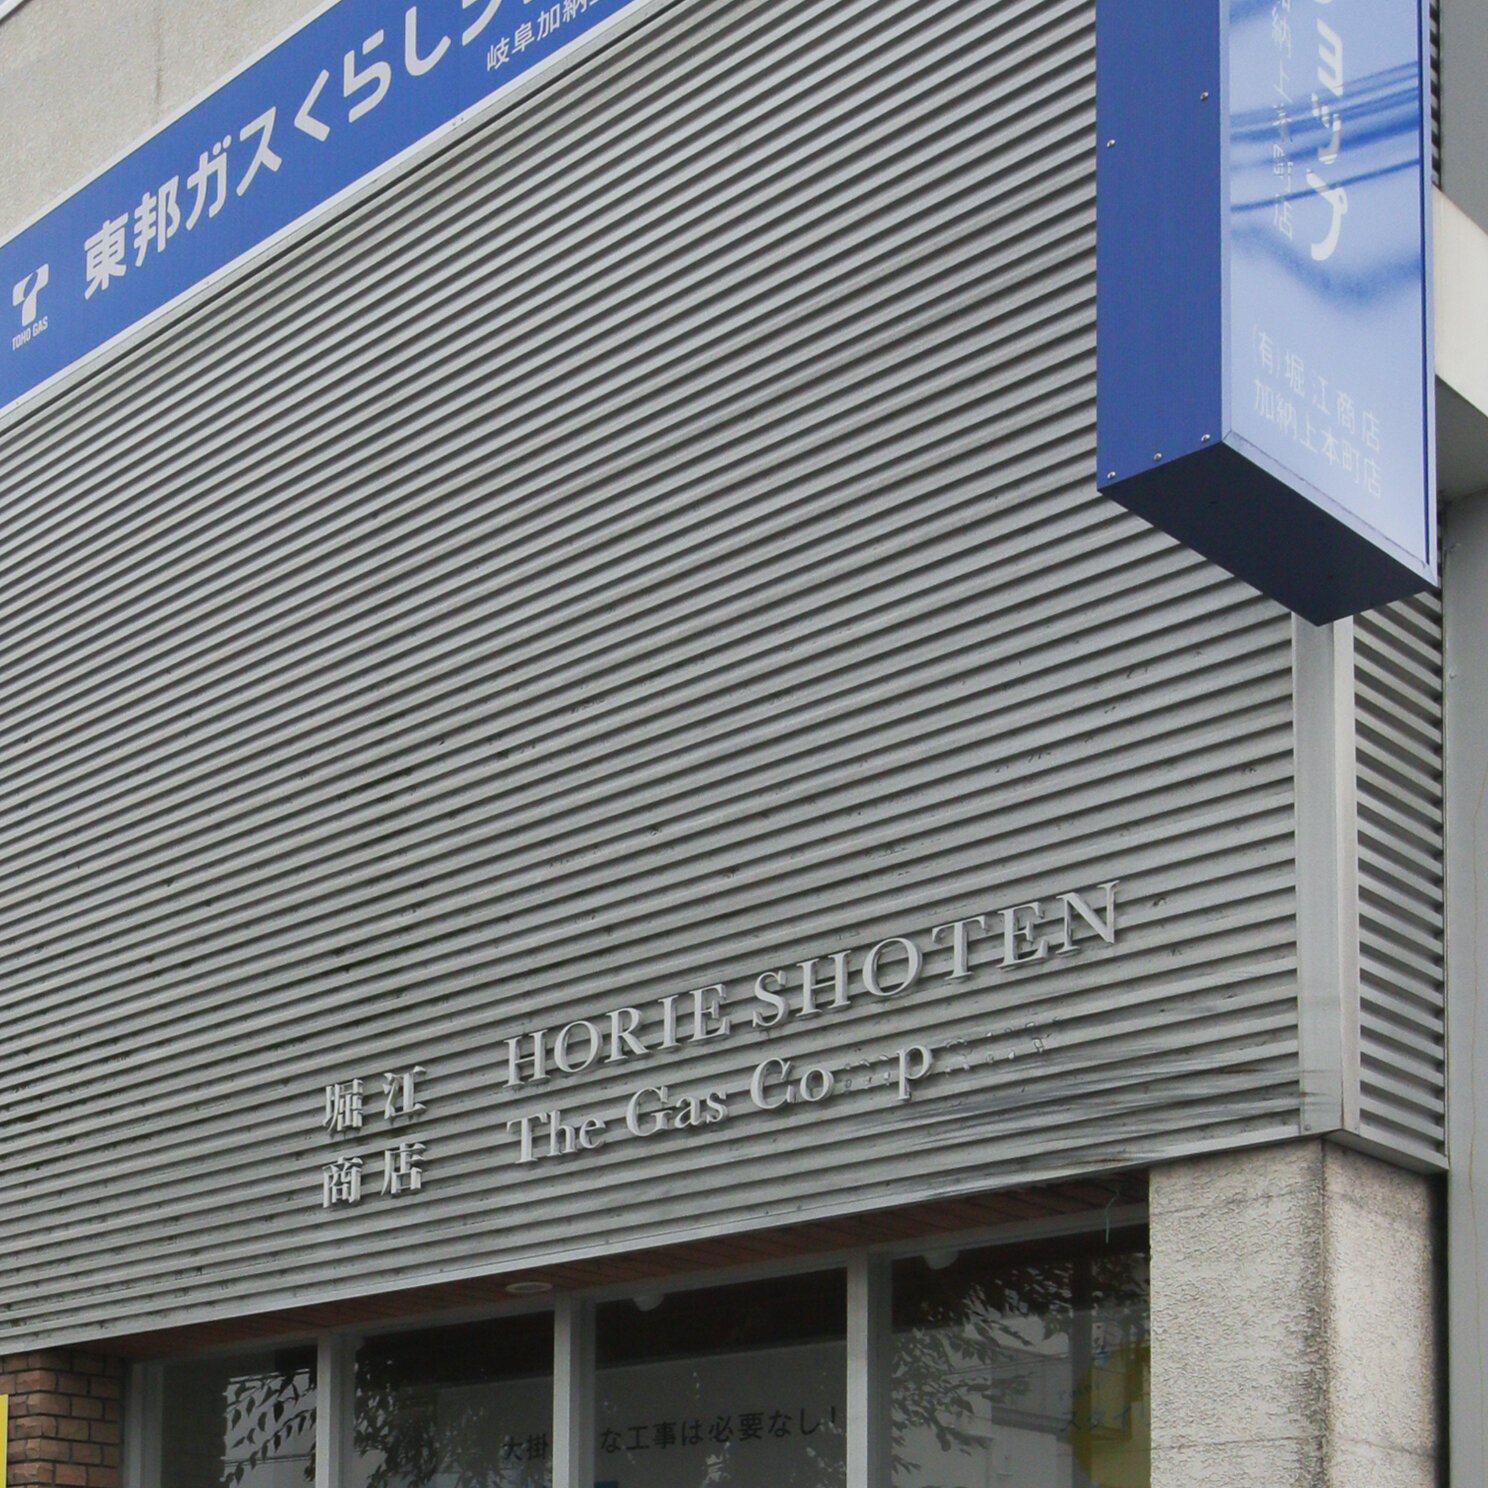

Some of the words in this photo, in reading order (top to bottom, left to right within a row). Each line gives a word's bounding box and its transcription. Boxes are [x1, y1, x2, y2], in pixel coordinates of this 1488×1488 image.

[12, 327, 31, 351] TOHO
[33, 315, 48, 337] GAS
[502, 984, 731, 1089] HORIE
[752, 880, 1120, 1030] SHOTEN
[323, 1065, 427, 1132] 堀江
[506, 1112, 605, 1165] The
[624, 1085, 727, 1138] Gas
[322, 1142, 426, 1208] 商店
